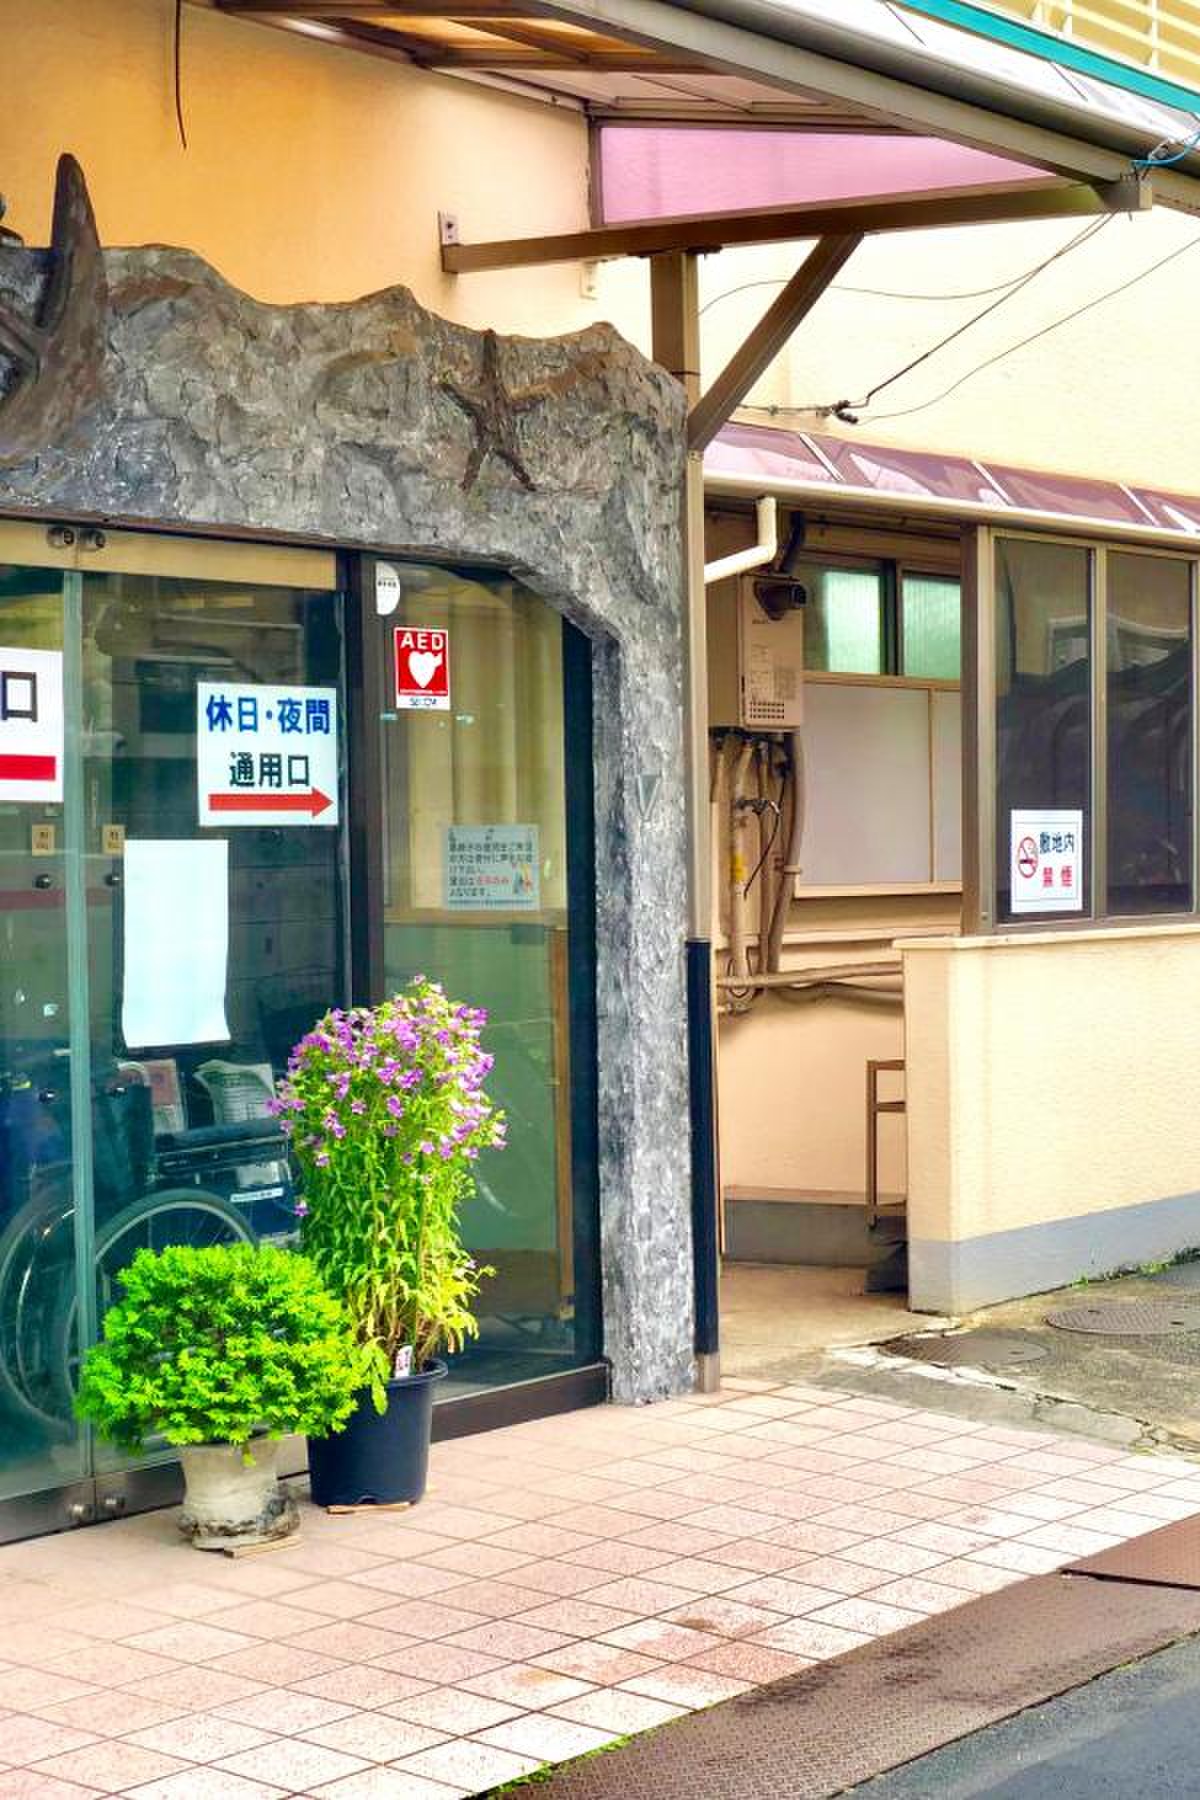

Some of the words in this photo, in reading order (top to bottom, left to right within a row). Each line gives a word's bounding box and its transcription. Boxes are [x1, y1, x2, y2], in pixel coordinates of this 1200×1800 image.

[400, 632, 445, 652] AED
[205, 694, 331, 735] 休日・夜間
[229, 751, 311, 789] 通用口
